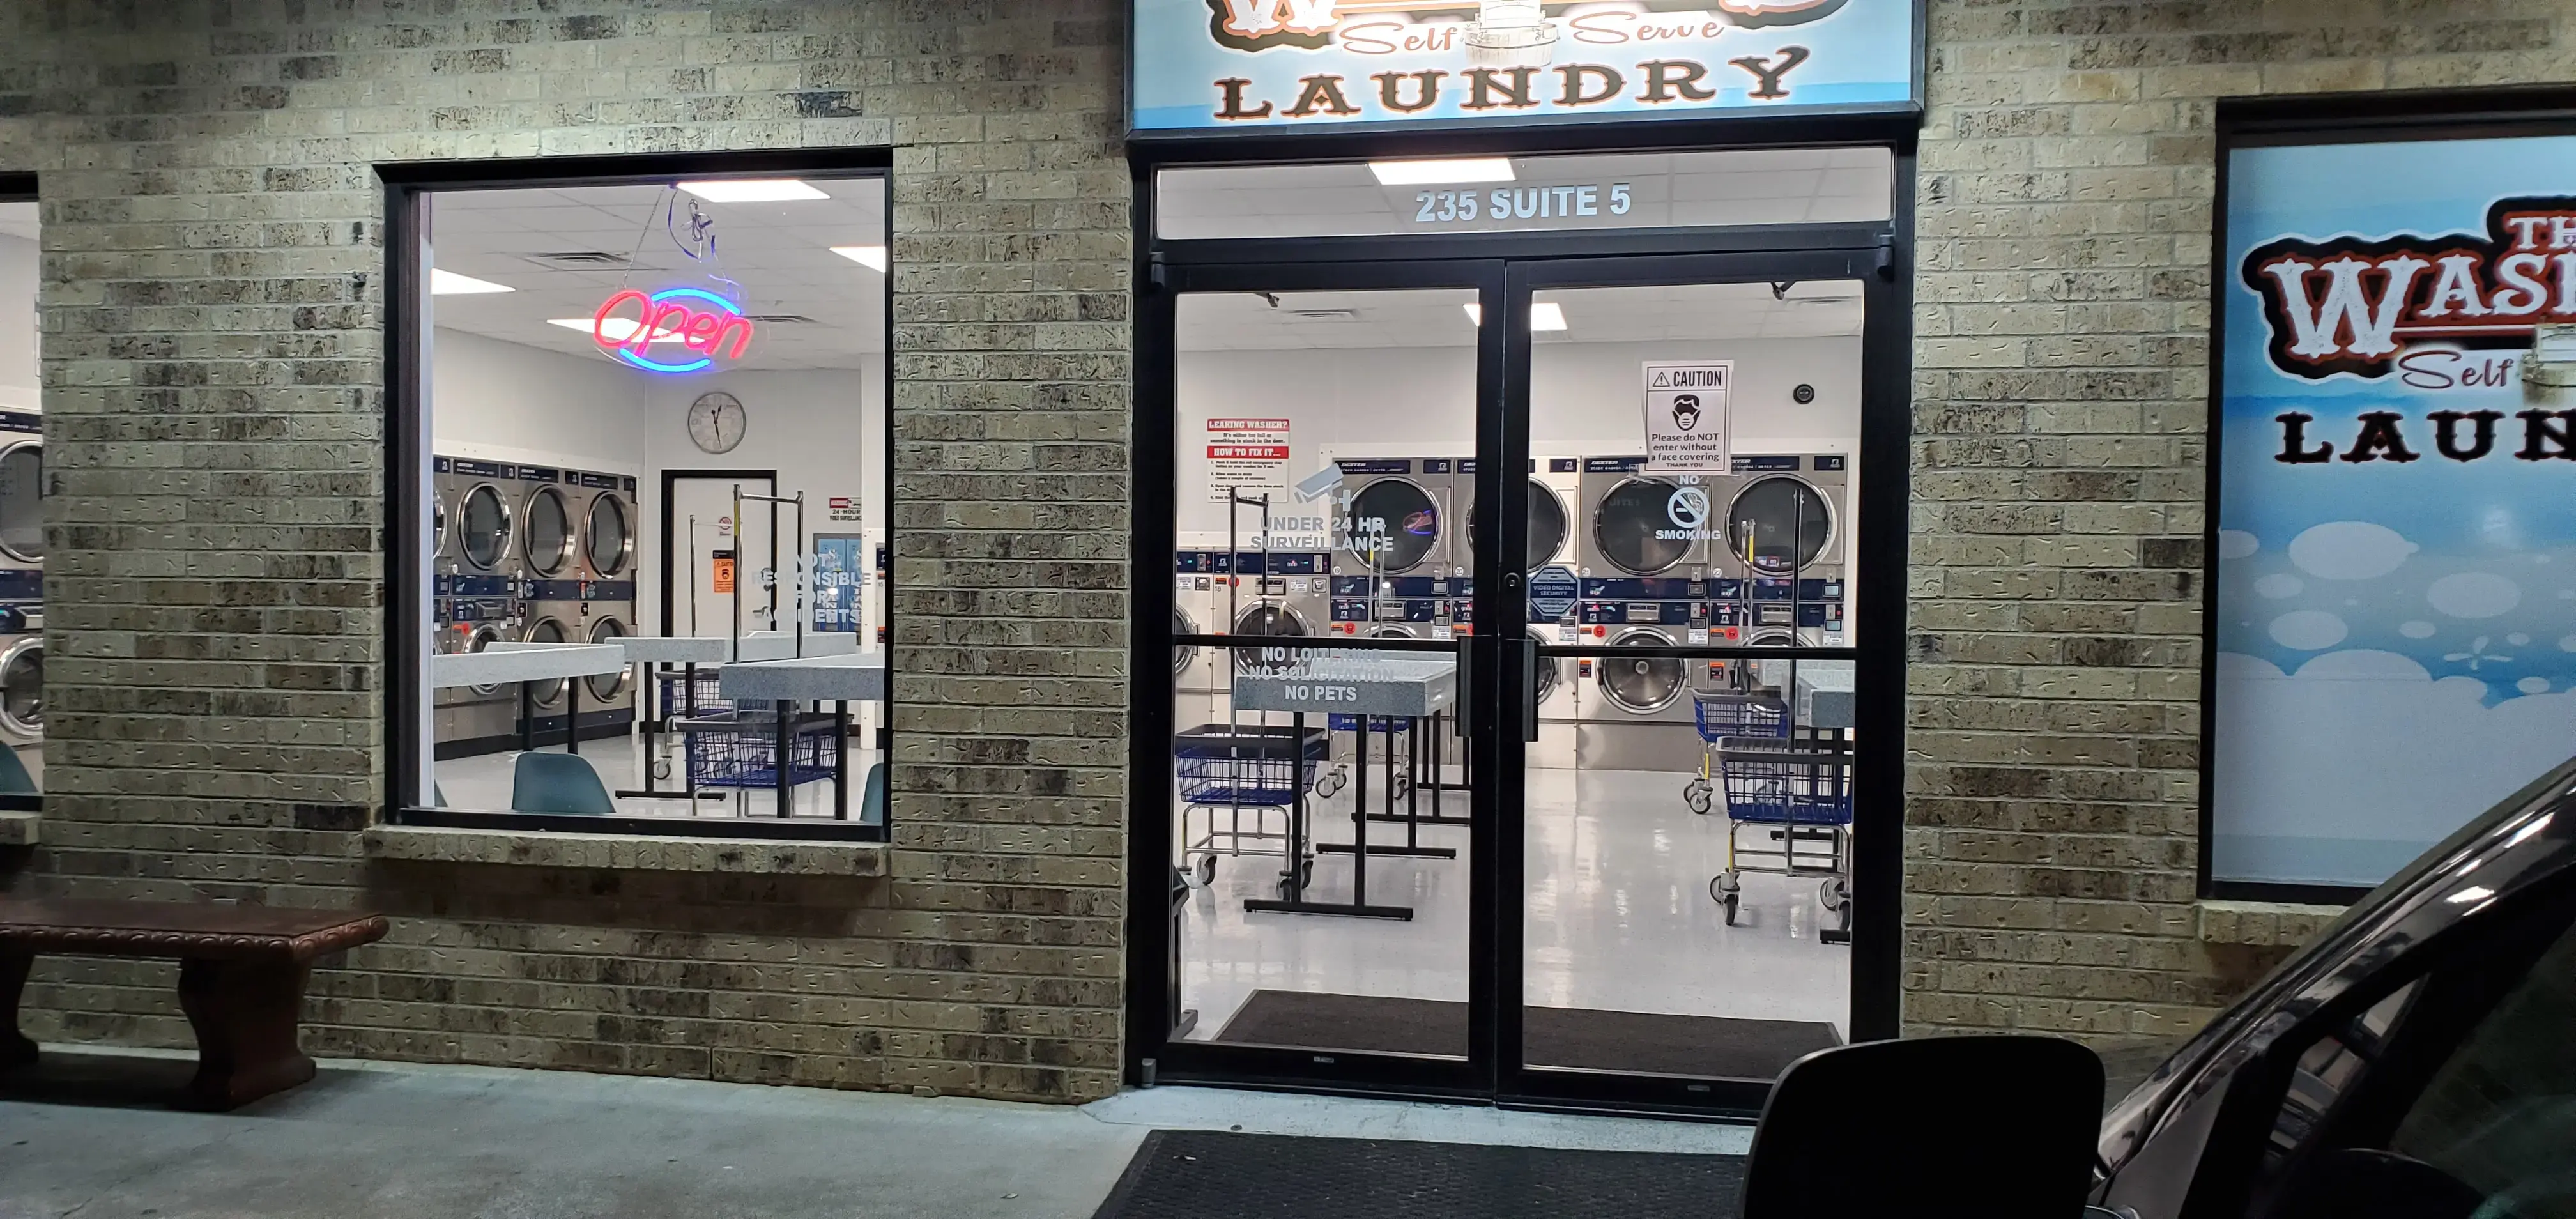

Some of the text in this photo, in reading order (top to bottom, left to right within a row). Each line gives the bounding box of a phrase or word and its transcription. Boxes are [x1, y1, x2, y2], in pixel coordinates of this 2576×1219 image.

[1339, 12, 1725, 54] Self Serve
[1213, 45, 1810, 120] LAUNDRY
[1415, 183, 1631, 222] 235 SUITE 5
[594, 290, 753, 359] Open
[2398, 349, 2515, 390] Self
[1673, 371, 1722, 387] CAUTION
[1680, 443, 1717, 451] without
[1679, 453, 1719, 462] covering
[1679, 475, 1699, 484] NO
[1260, 517, 1386, 532] UNDER 24 HR
[1250, 535, 1393, 551] SURVEILLANCE
[1655, 530, 1721, 540] SMOKING
[1262, 647, 1285, 661] NO
[1249, 665, 1273, 680] NO
[1285, 685, 1356, 702] NO PETS
